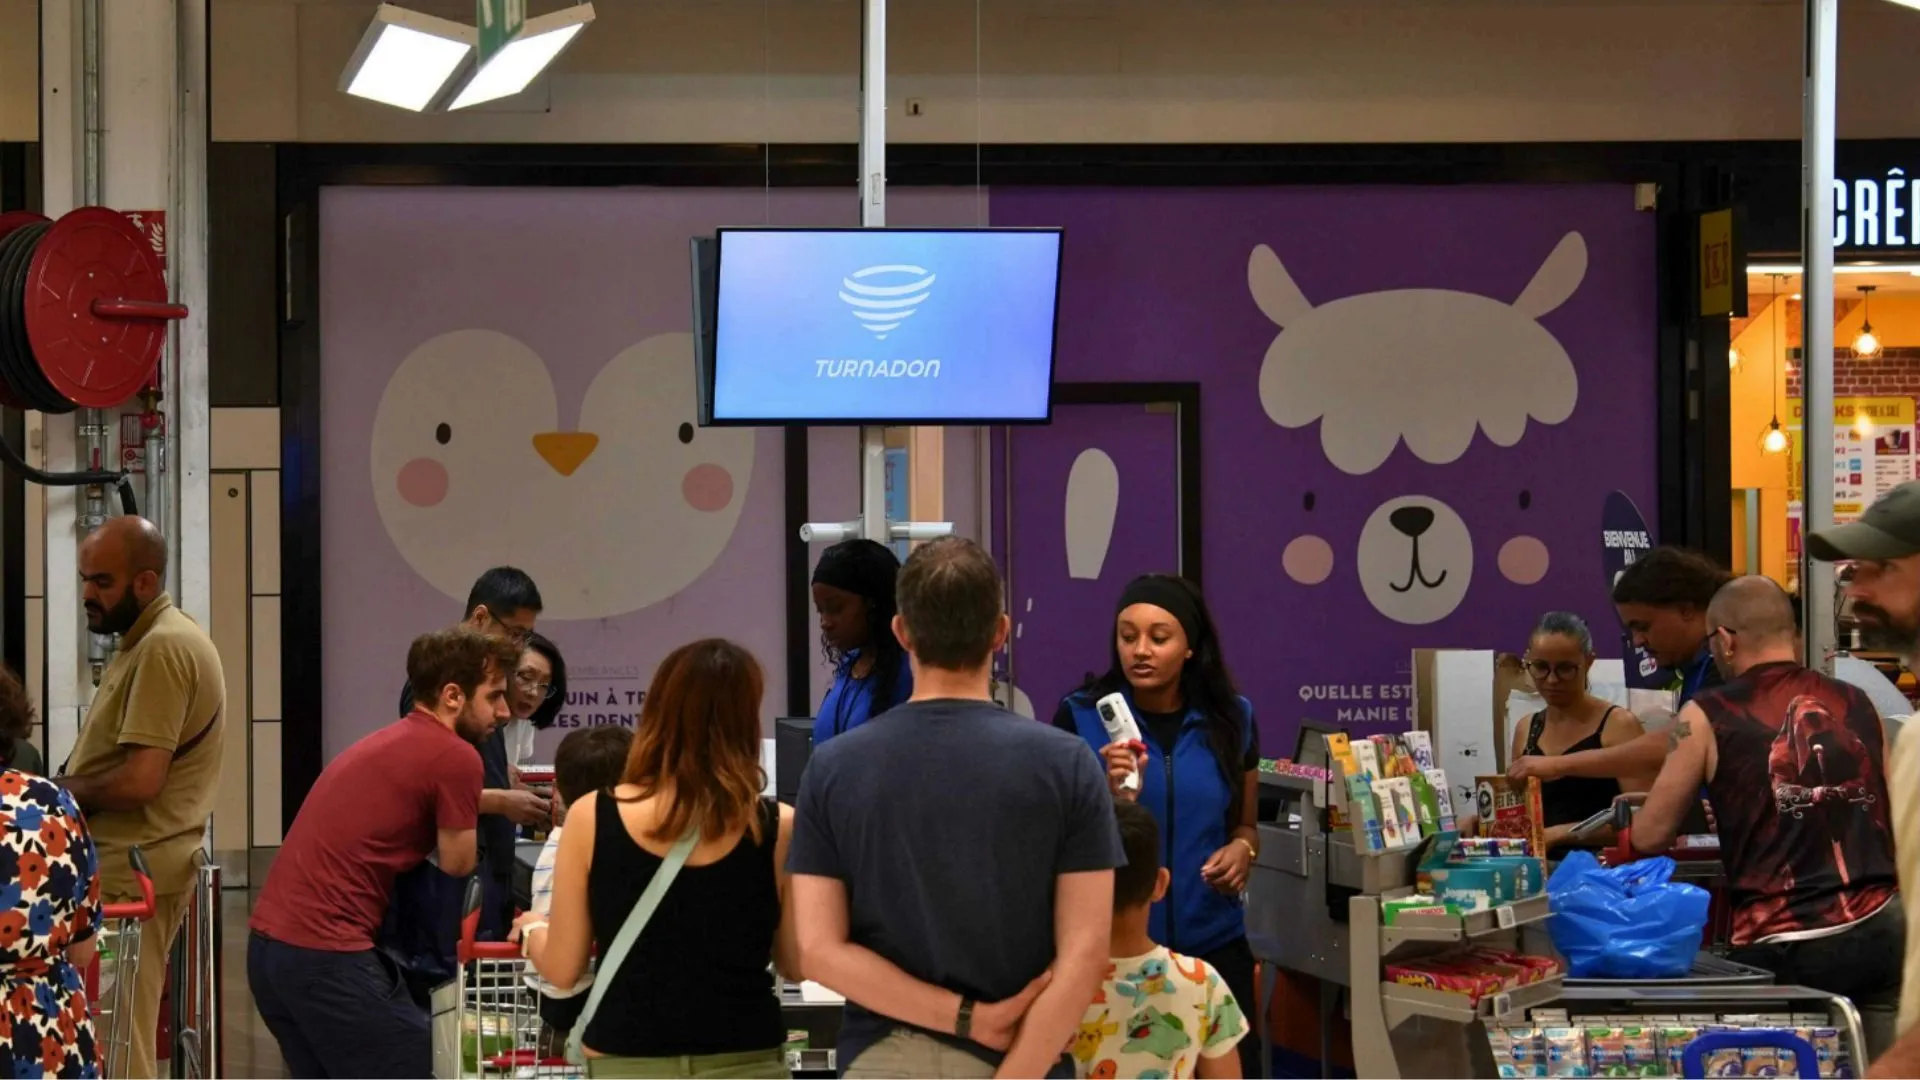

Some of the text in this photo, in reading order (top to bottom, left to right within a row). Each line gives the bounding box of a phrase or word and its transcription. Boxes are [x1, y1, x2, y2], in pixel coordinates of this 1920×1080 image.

[815, 359, 941, 378] TURNADON
[1603, 530, 1651, 548] BIENVENUE
[565, 691, 599, 706] UIN
[606, 687, 618, 706] À
[1299, 684, 1413, 703] QUELLE EST
[1337, 706, 1399, 722] MANIE
